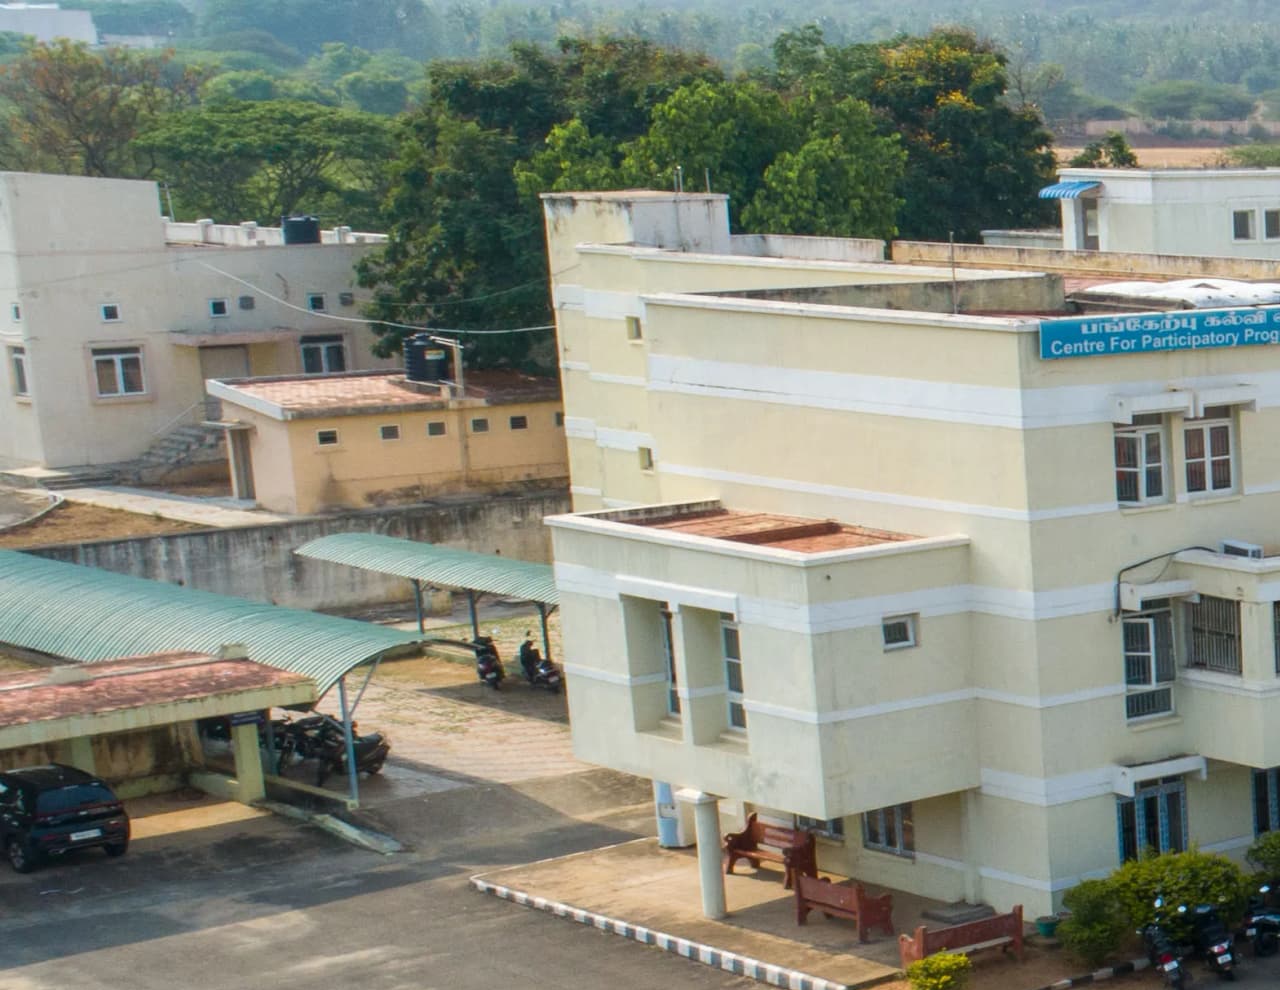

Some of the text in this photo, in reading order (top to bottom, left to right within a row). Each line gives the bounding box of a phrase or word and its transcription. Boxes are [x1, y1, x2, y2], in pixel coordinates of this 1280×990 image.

[1080, 316, 1198, 334] பங்கேற்பு
[1204, 310, 1268, 327] கல்வி
[1051, 338, 1106, 355] Centre
[1110, 336, 1138, 351] For
[1141, 332, 1239, 349] Participatory
